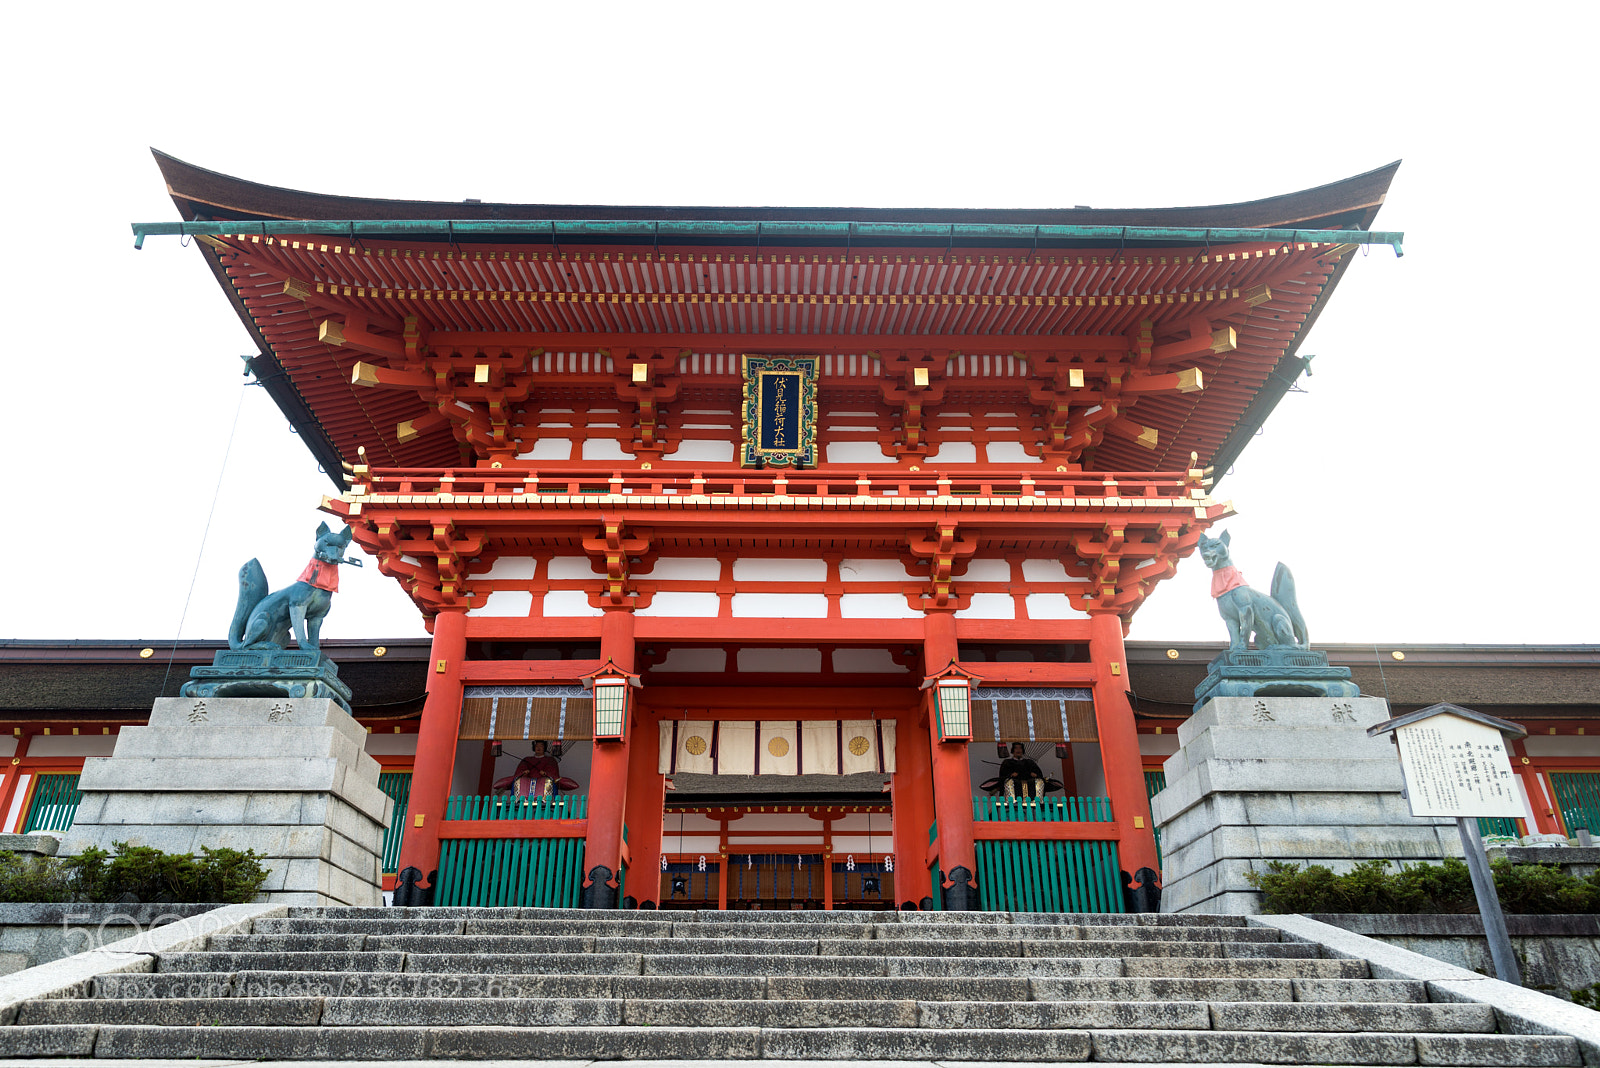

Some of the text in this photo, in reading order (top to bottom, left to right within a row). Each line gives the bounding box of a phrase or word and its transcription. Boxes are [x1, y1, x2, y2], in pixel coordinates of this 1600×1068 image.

[773, 377, 788, 447] 伏見稲荷大社
[187, 701, 293, 723] 奉 献
[1252, 700, 1357, 723] 奉 献
